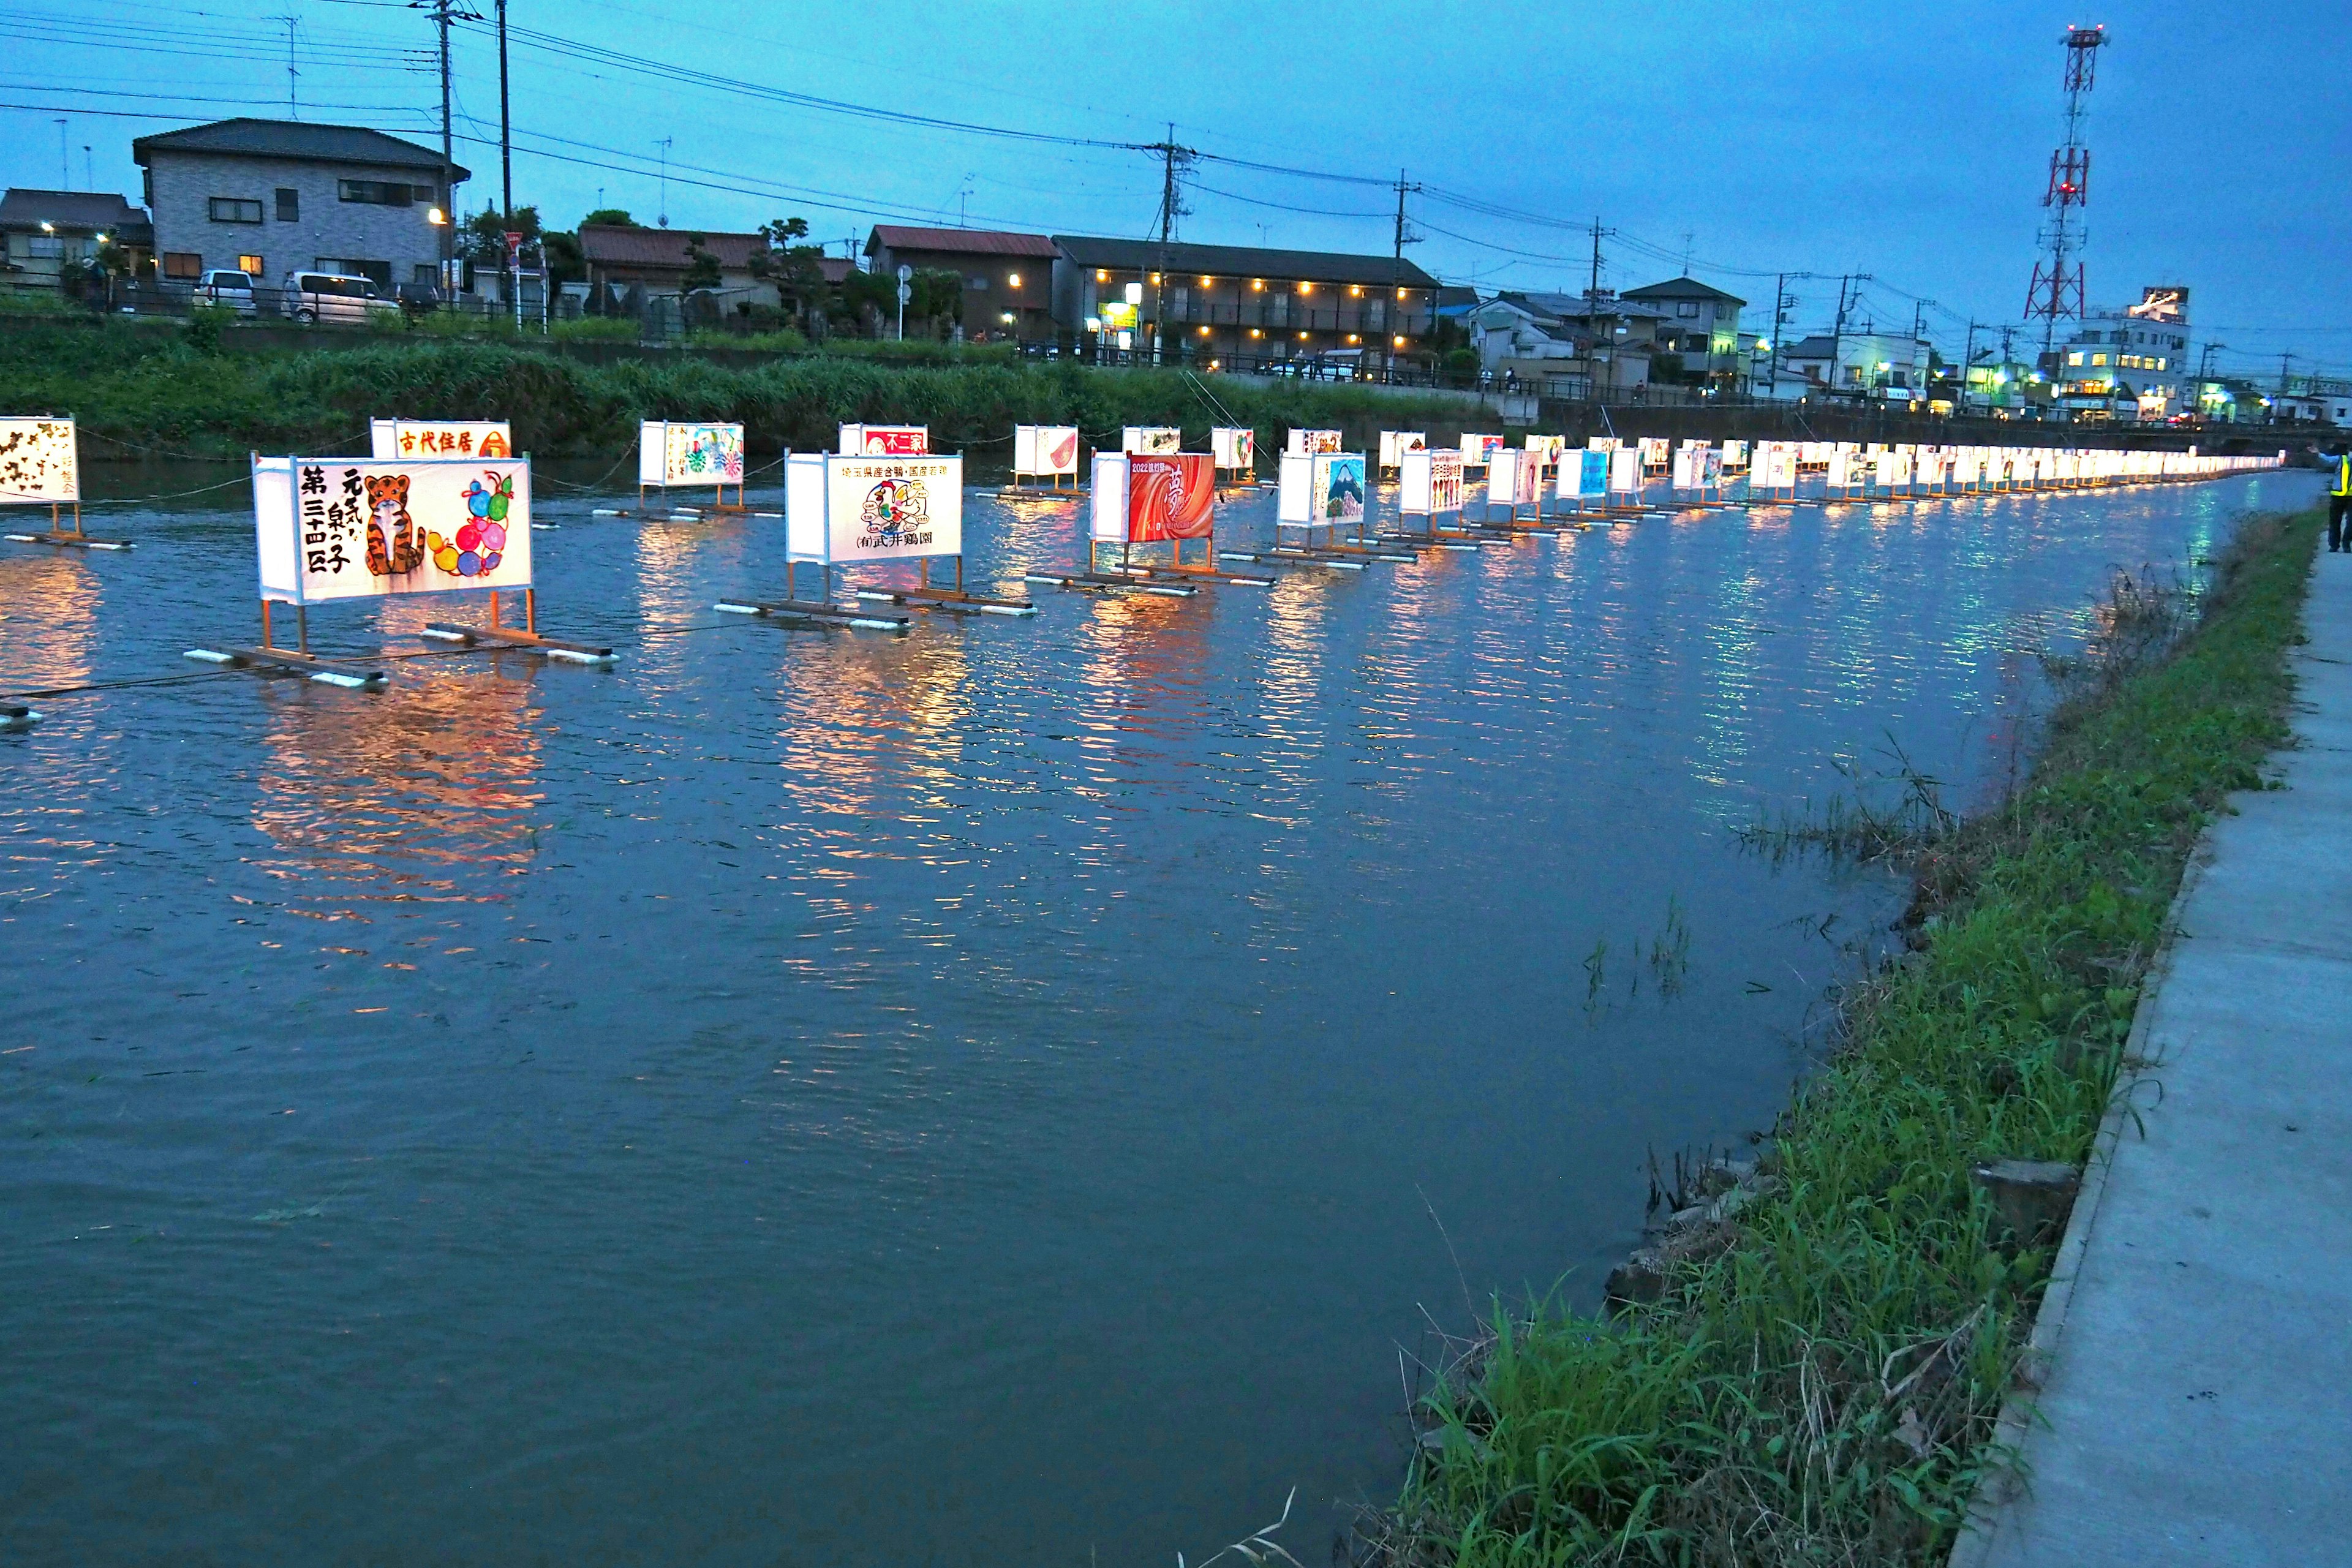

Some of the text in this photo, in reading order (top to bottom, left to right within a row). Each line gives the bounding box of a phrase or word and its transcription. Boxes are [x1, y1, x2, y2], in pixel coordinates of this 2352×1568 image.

[399, 431, 473, 453] 古代住居
[887, 433, 922, 451] 不二家
[301, 466, 327, 573] 第三十四区
[342, 469, 363, 541] 元気な
[1164, 464, 1183, 515] 夢
[327, 502, 350, 573] 泉っ子
